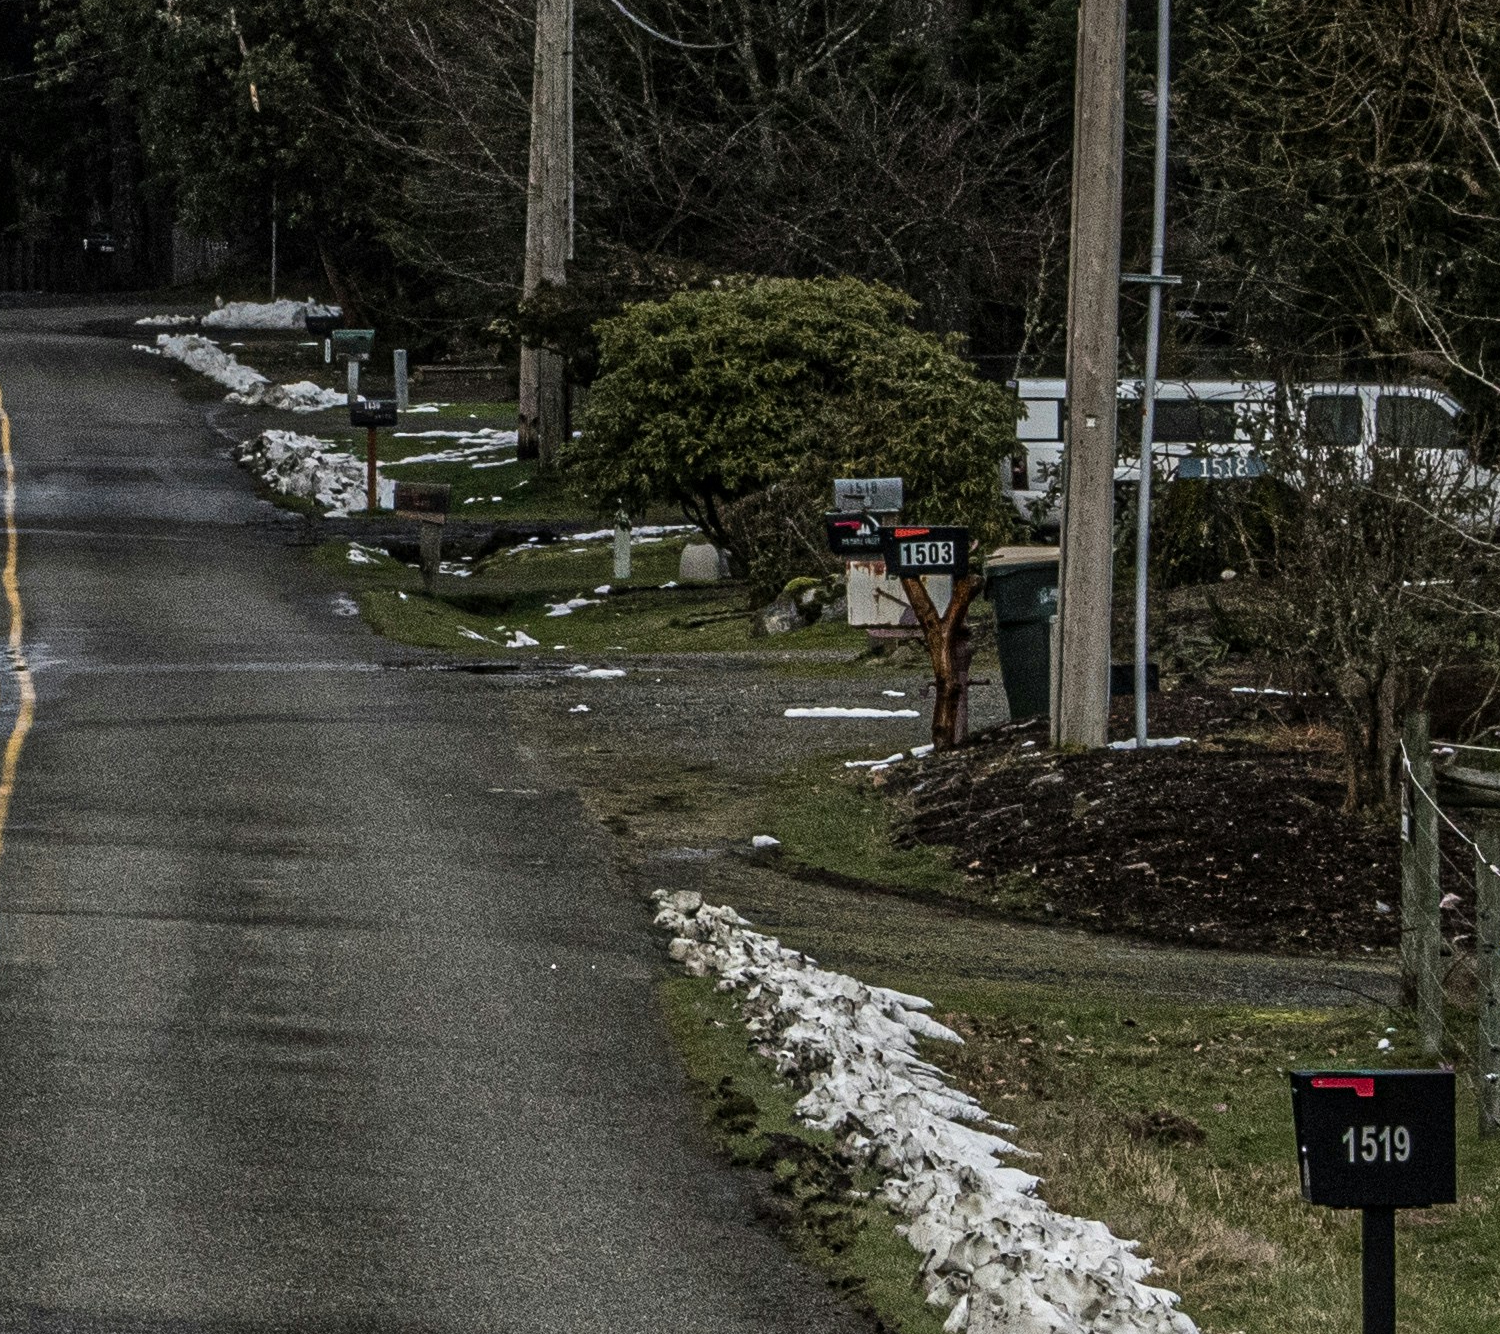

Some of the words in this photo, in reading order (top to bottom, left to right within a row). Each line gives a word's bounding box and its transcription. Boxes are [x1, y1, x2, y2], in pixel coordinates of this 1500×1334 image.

[1200, 457, 1248, 478] 1518
[903, 542, 952, 565] 1503
[1342, 1125, 1410, 1163] 1519
